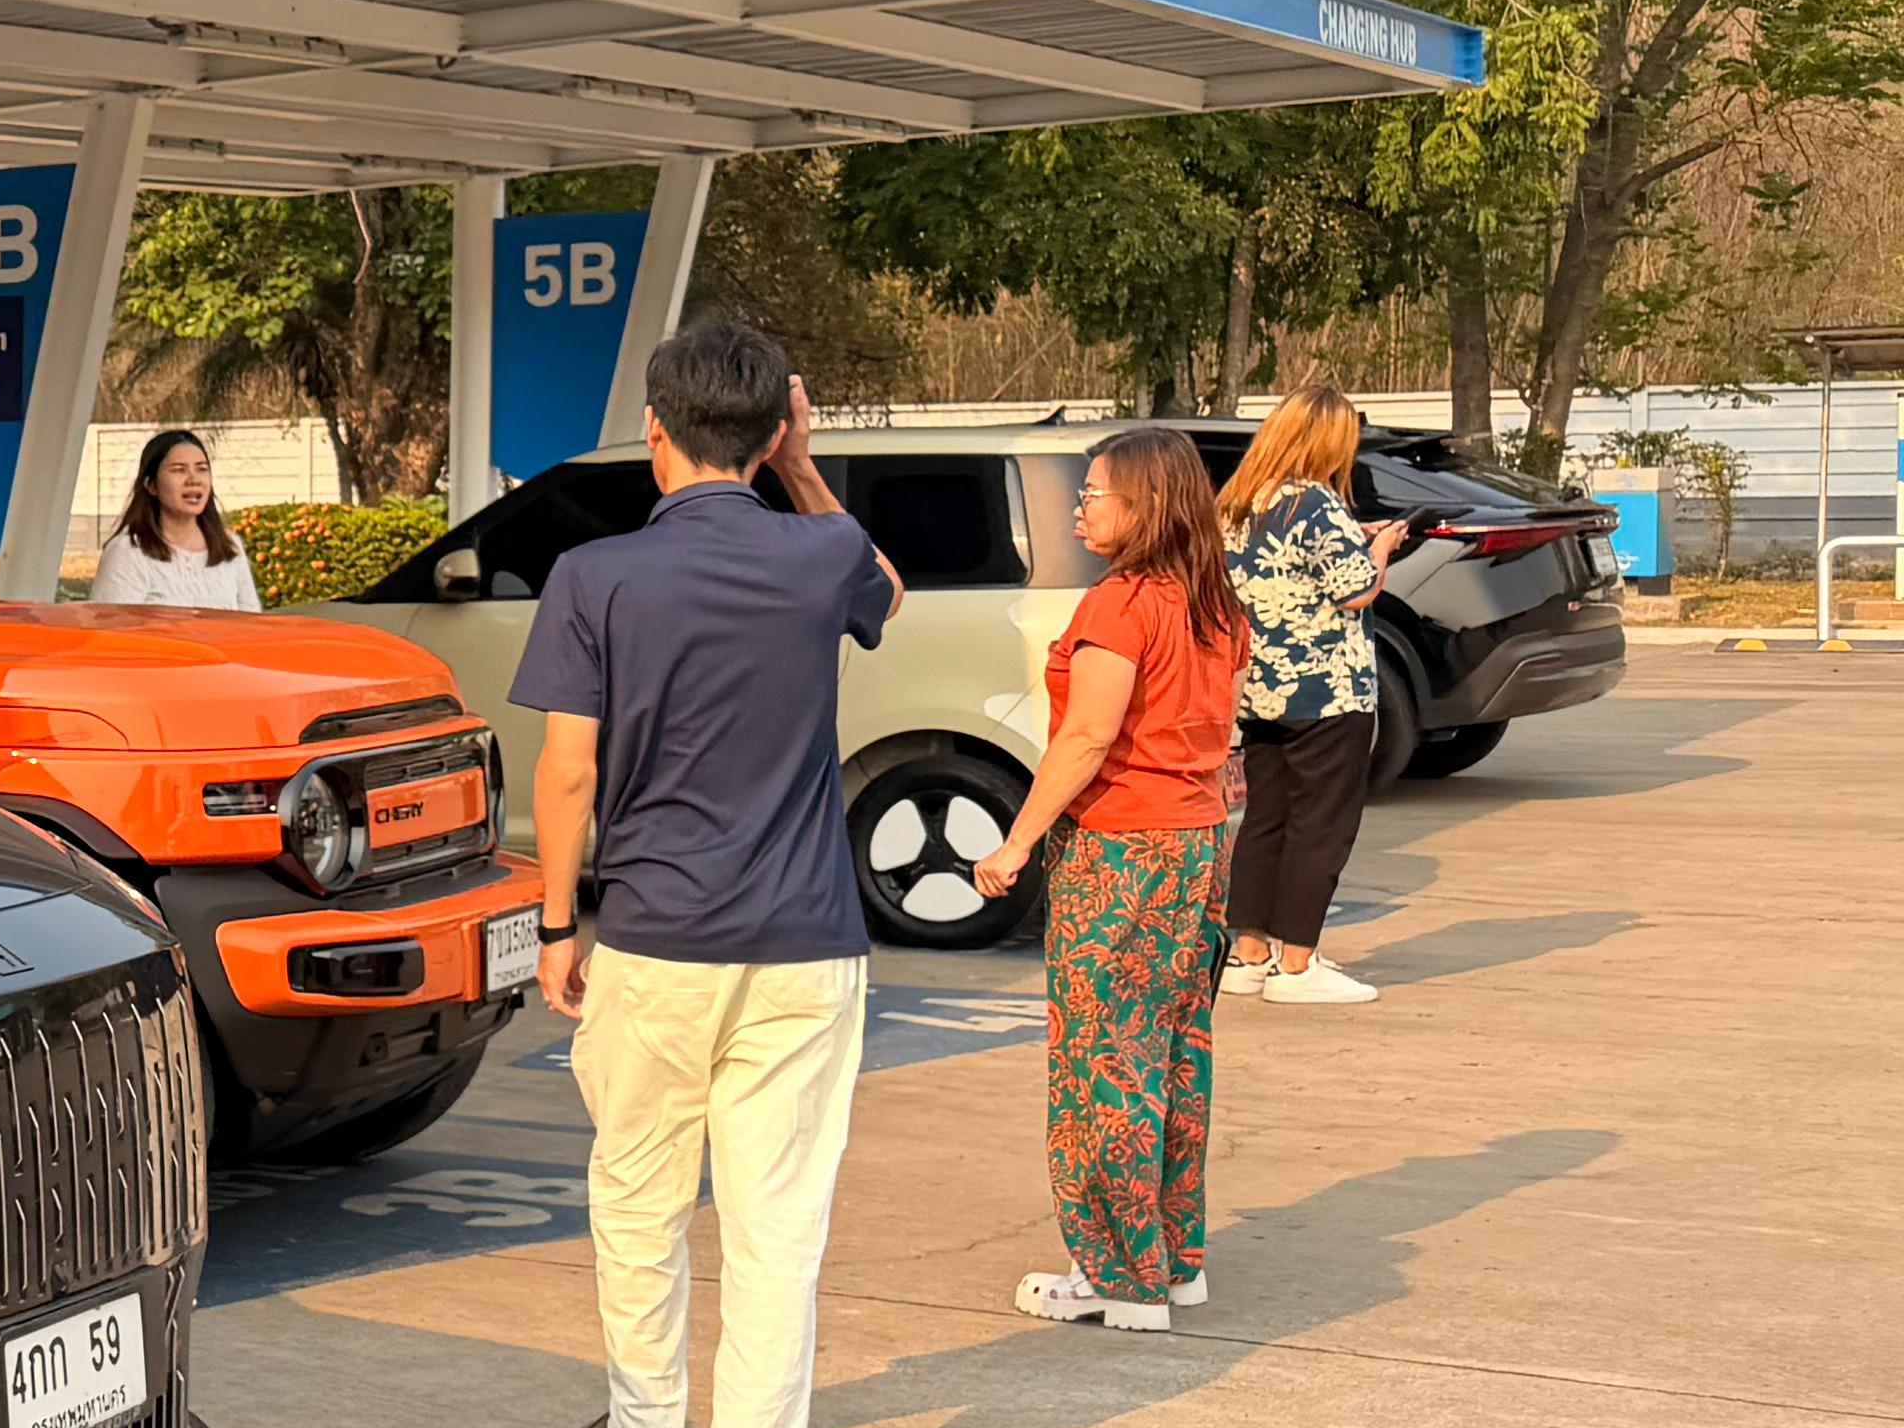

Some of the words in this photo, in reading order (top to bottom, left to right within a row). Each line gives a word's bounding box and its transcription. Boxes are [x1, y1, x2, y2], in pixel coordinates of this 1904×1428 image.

[1390, 17, 1417, 66] HUB
[523, 241, 617, 308] 5B
[339, 1170, 590, 1227] 3B
[12, 1335, 69, 1404] 4กก
[89, 1314, 121, 1372] 59
